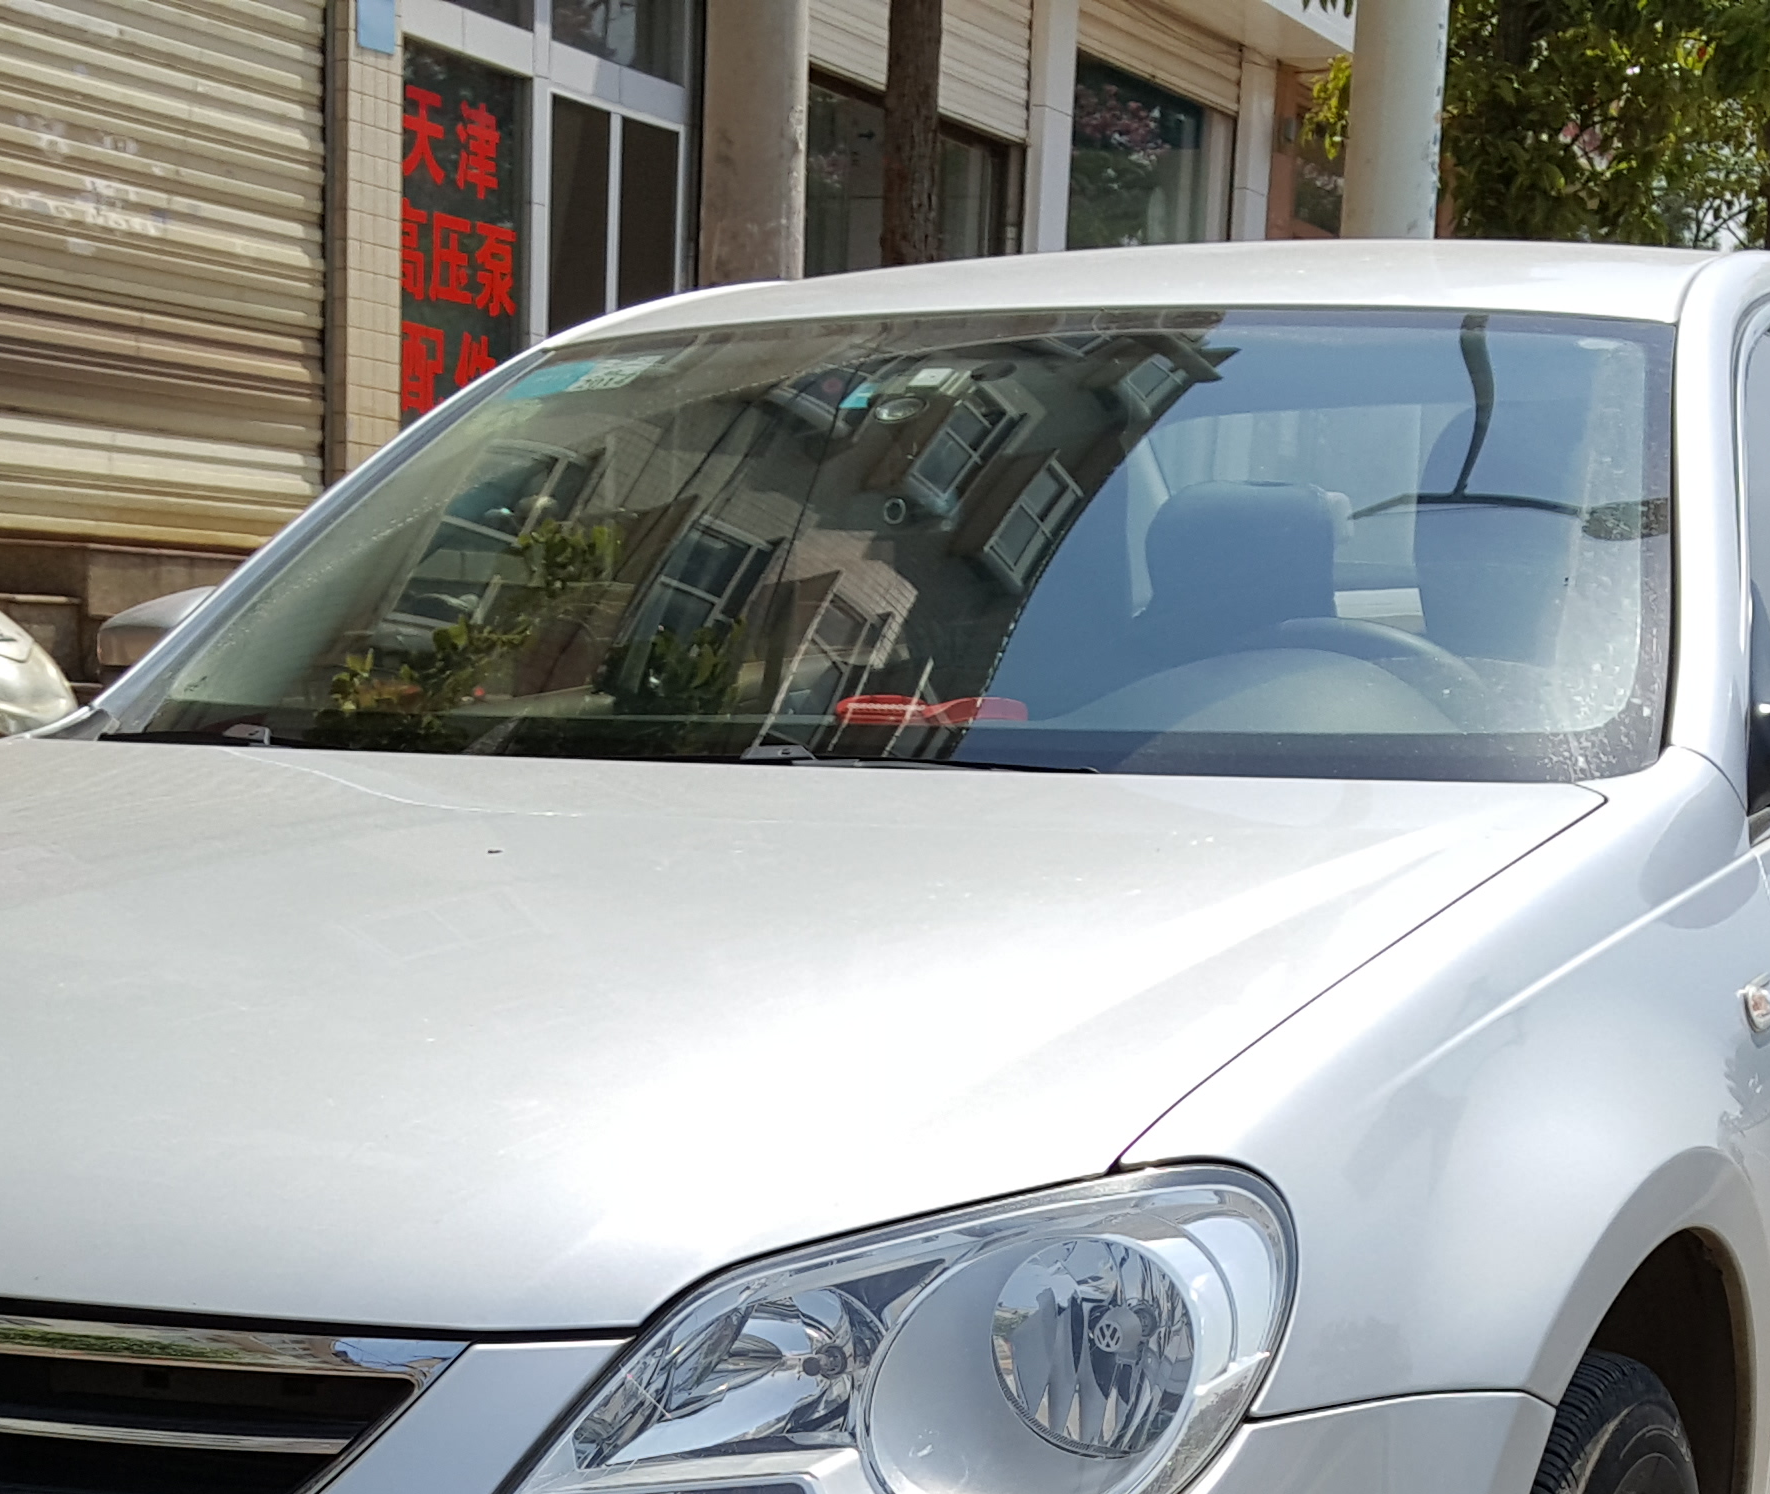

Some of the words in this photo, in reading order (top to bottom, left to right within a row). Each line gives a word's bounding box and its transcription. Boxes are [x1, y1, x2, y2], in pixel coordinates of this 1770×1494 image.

[403, 84, 501, 200] 天津
[402, 197, 517, 317] 高压泵
